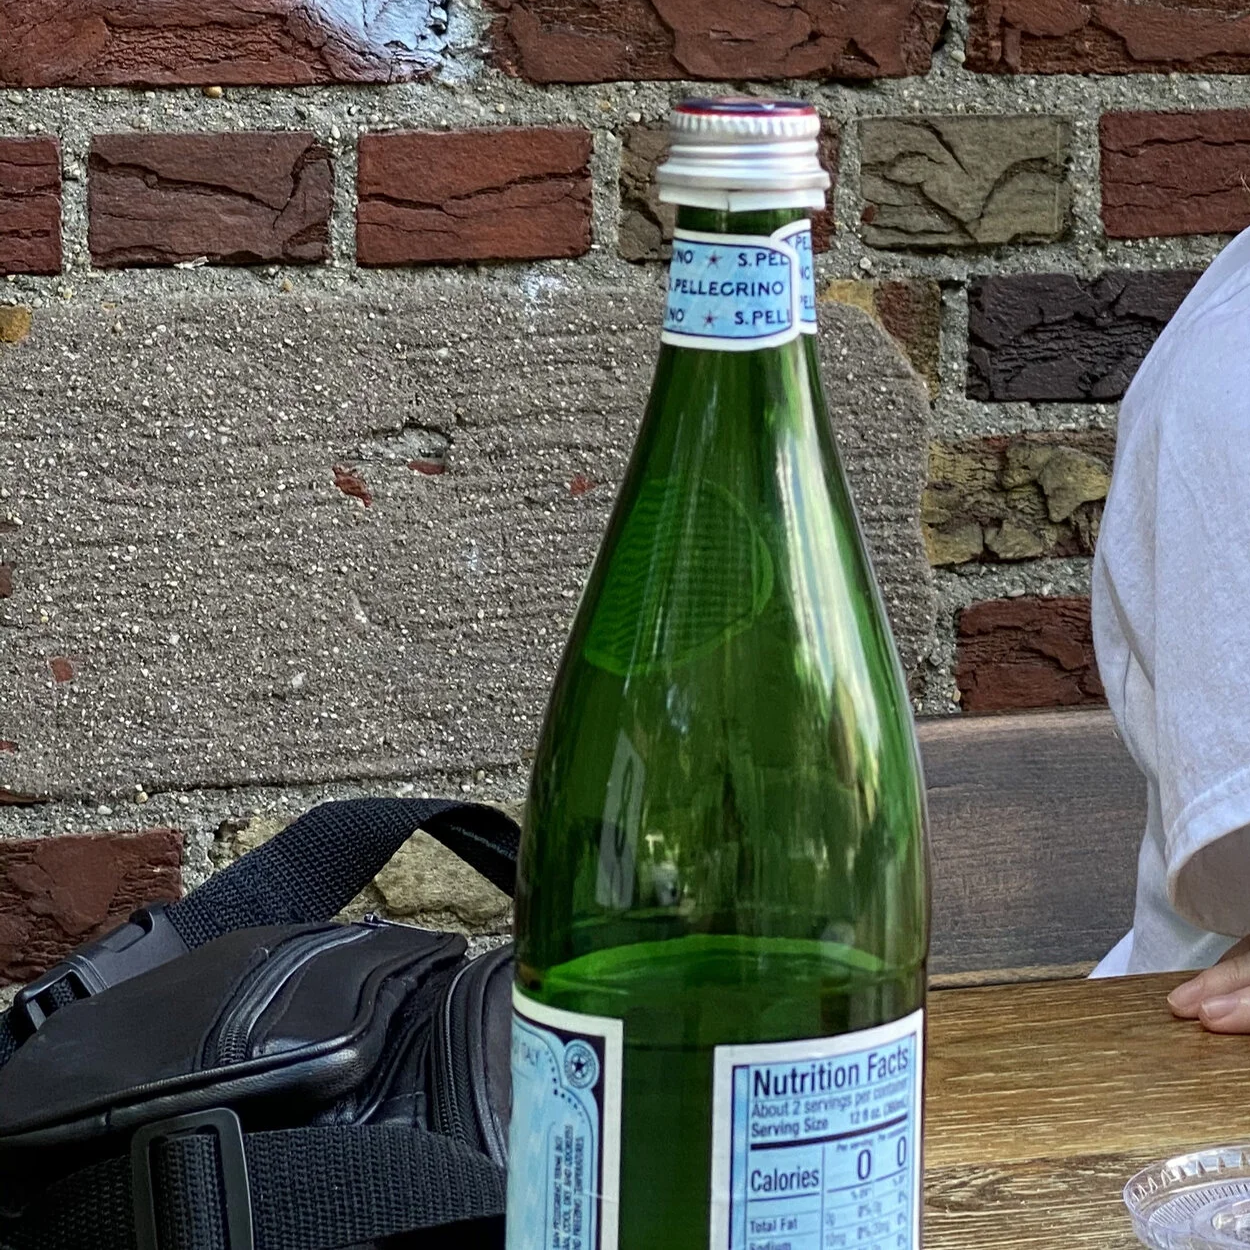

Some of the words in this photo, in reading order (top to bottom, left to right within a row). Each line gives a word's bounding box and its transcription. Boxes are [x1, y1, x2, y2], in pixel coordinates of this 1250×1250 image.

[753, 1061, 860, 1097] Nutrition
[867, 1044, 909, 1081] Facts
[752, 1100, 789, 1118] About
[792, 1100, 801, 1115] 2
[804, 1094, 852, 1113] servings
[752, 1120, 800, 1138] Serving
[804, 1117, 828, 1131] Size
[751, 1166, 820, 1192] Calories
[857, 1149, 871, 1180] 0
[897, 1135, 907, 1167] 0
[750, 1219, 777, 1234] Total
[780, 1217, 798, 1231] Fat
